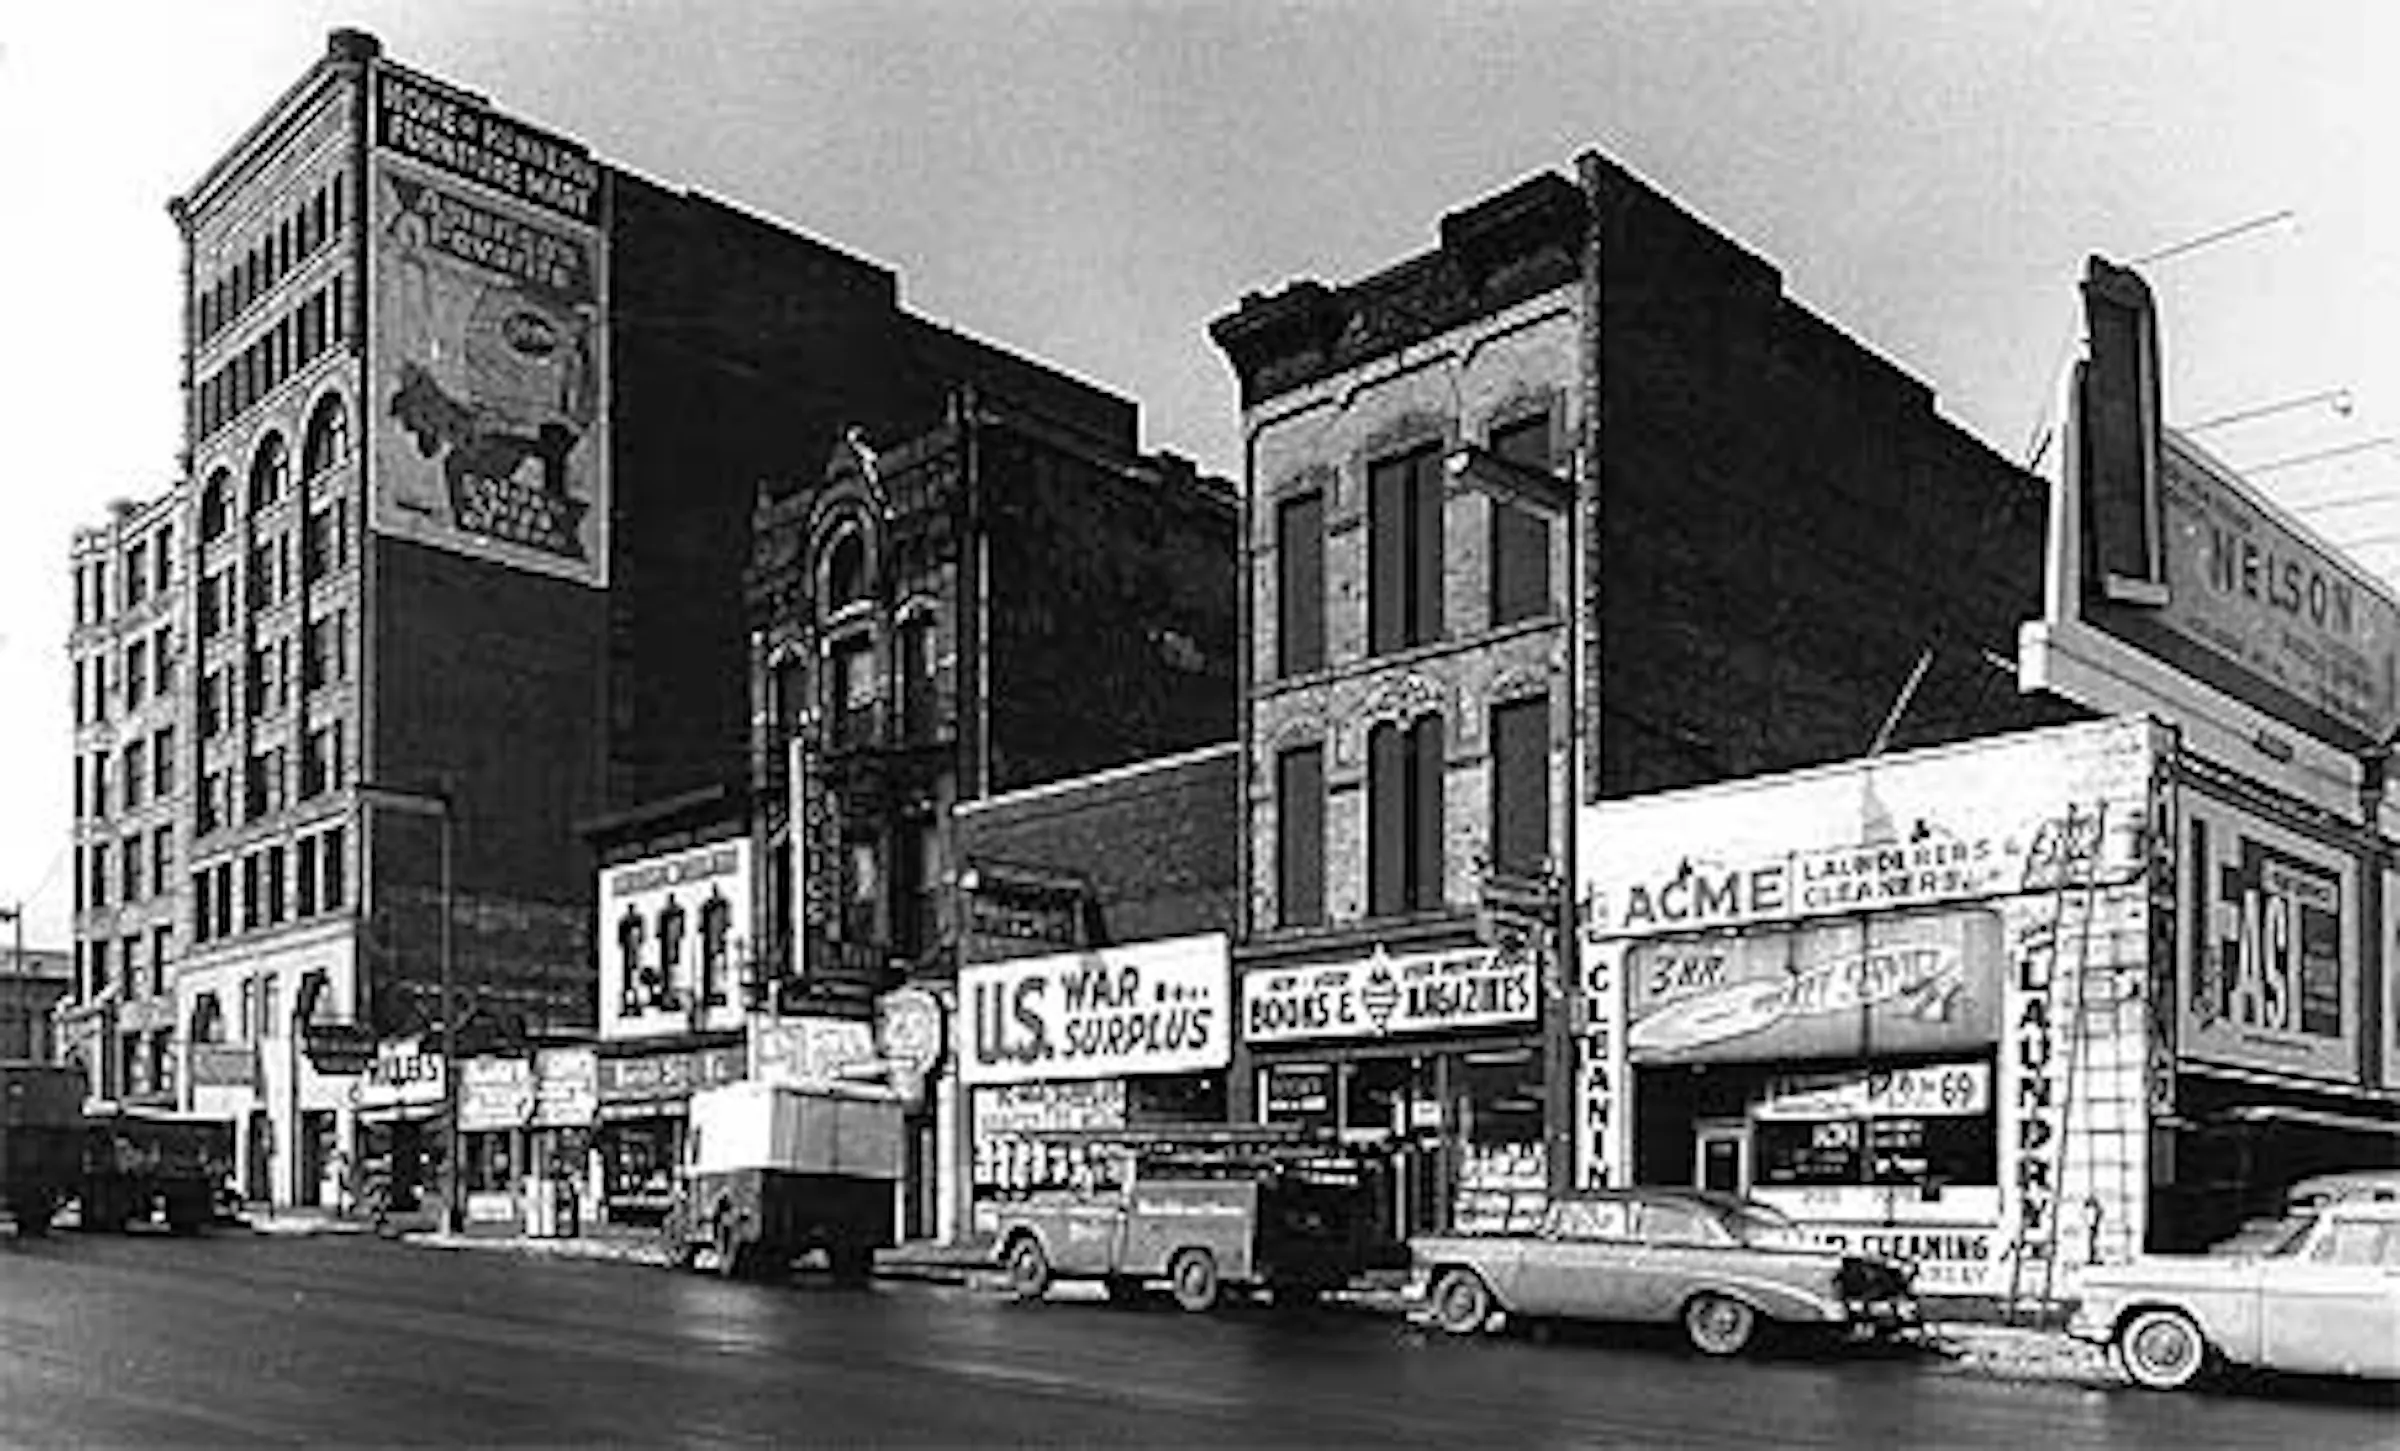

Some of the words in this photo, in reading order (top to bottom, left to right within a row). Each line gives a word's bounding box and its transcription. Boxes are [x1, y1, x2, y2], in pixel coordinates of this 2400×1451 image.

[1624, 865, 1783, 928] ACME
[976, 976, 1053, 1065] U.S.
[1061, 966, 1139, 1011] WAR
[1061, 1009, 1212, 1056] SURPLUS
[1588, 961, 1611, 1189] CLEANIN
[2017, 960, 2052, 1229] LAUNDRY
